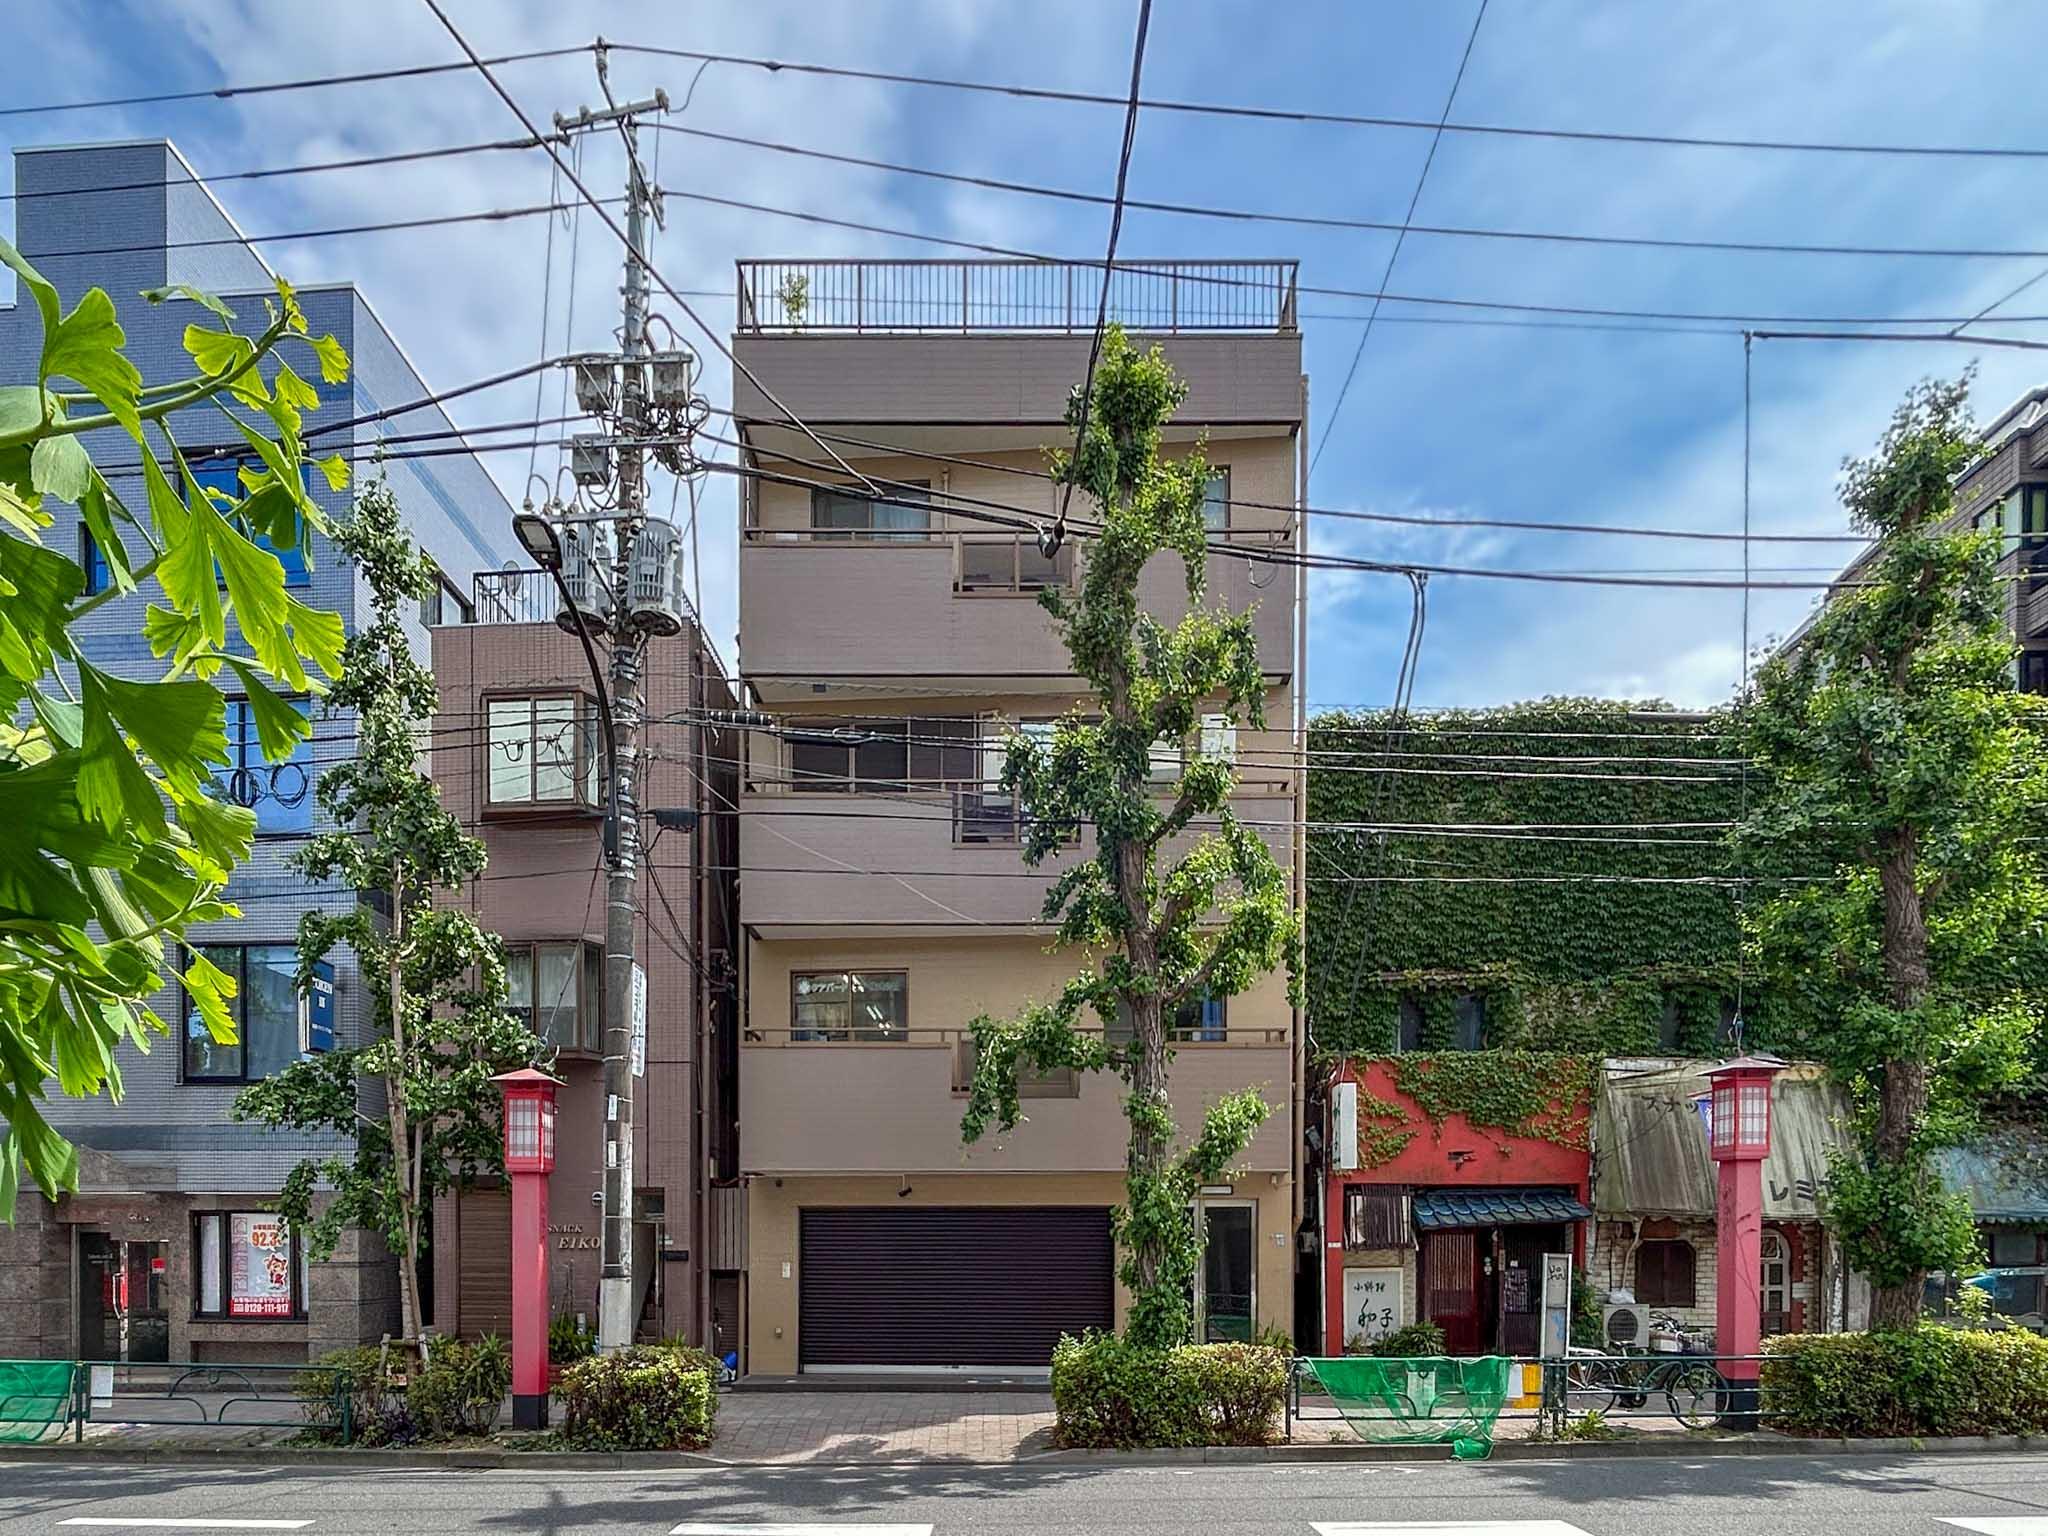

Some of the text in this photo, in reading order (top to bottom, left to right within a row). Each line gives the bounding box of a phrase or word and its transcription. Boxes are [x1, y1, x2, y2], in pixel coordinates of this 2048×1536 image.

[1641, 1095, 1699, 1113] スナッ
[558, 1236, 601, 1249] EIKO
[1358, 1298, 1393, 1328] 和子
